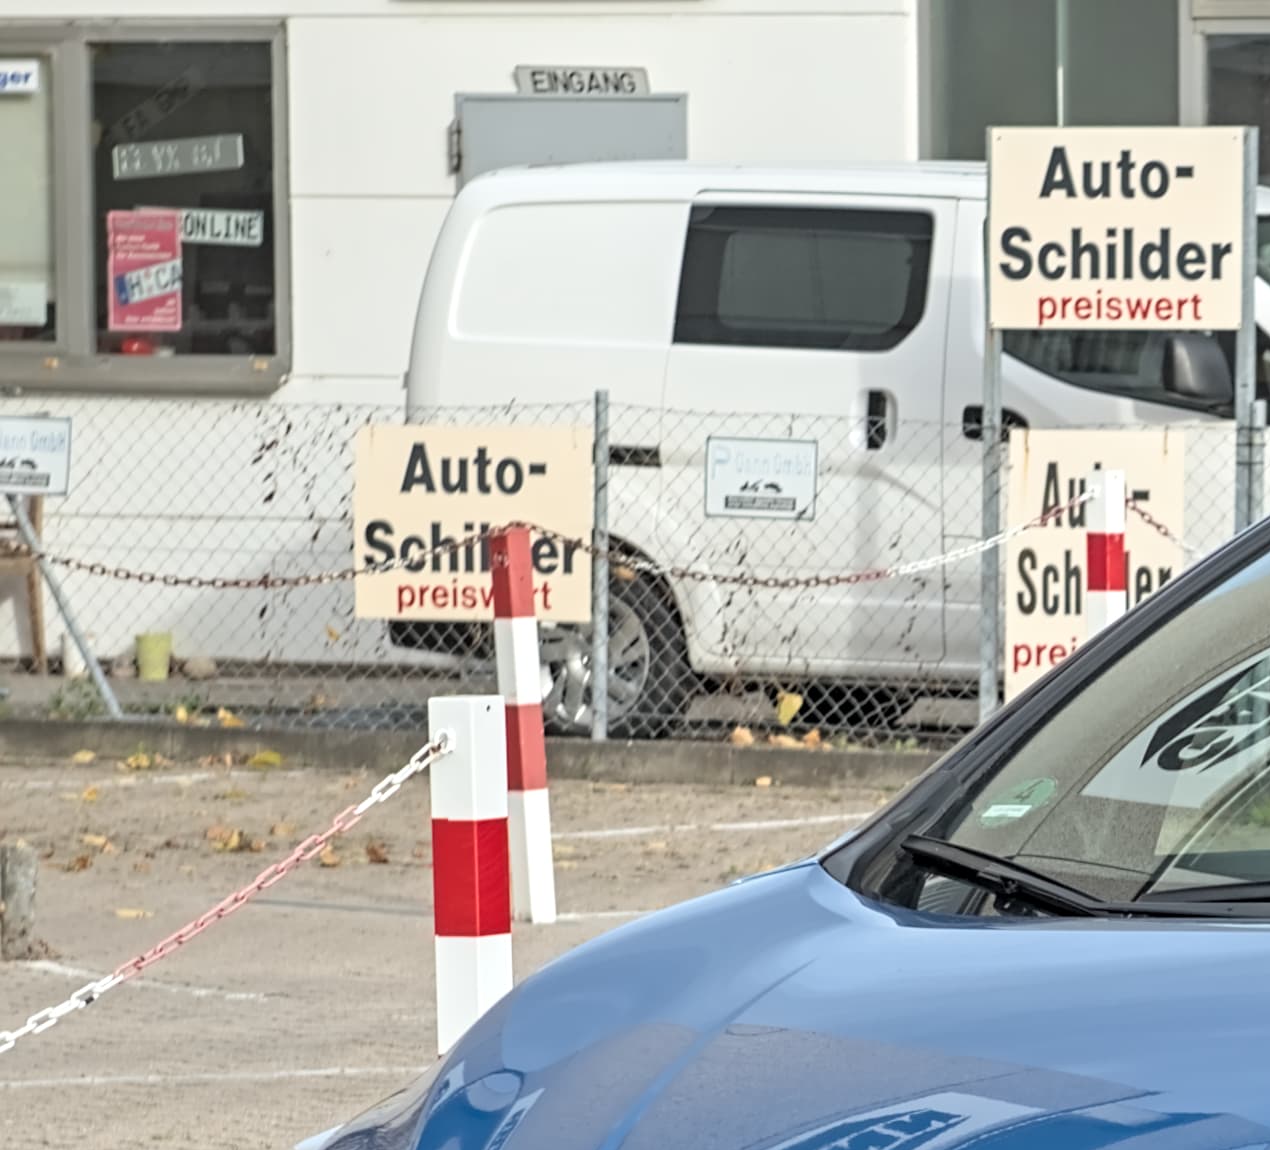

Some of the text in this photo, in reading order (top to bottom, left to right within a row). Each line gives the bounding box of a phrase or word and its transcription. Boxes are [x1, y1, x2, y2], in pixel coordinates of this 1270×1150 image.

[531, 71, 636, 94] EINGANG
[1039, 146, 1194, 199] Auto-
[183, 213, 261, 240] ONLINE
[999, 226, 1232, 281] Schilder
[1038, 289, 1203, 326] preiswert
[400, 442, 547, 494] Auto-
[1040, 461, 1150, 528] Au-
[364, 519, 582, 575] Schiler
